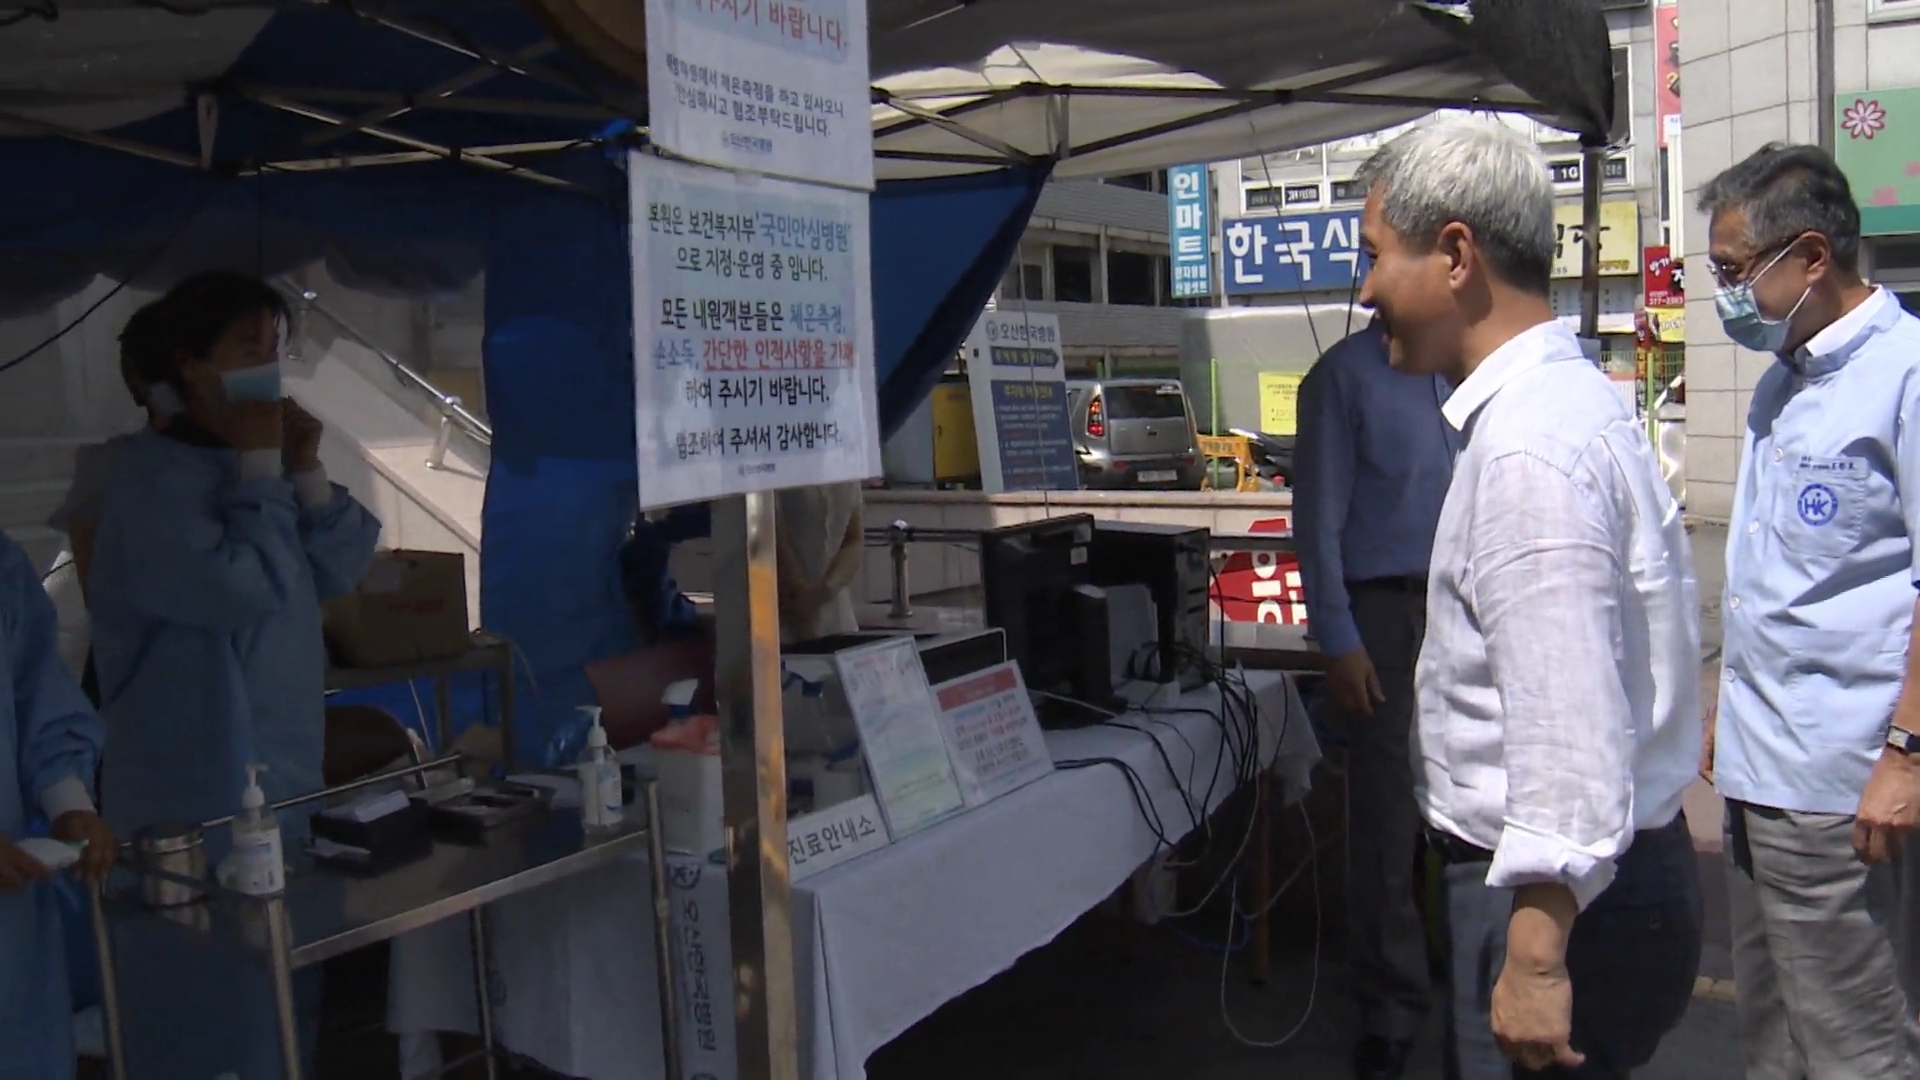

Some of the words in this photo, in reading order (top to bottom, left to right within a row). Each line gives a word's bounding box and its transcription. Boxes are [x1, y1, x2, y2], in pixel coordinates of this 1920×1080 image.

[769, 0, 848, 51] 바랍니다.
[779, 87, 804, 109] 하고
[803, 92, 845, 118] 있사오니
[732, 103, 831, 138] 협조부탁드립니다.
[648, 203, 684, 235] 본원은
[1173, 171, 1203, 261] 인마트
[676, 247, 702, 272] 으로
[770, 253, 783, 280] 중
[788, 256, 828, 282] 입니다.
[1226, 217, 1361, 284] 한국식
[661, 298, 688, 330] 모든
[693, 298, 783, 331] 내원객분들은
[789, 303, 846, 334] 체온측정,
[653, 339, 699, 370] 손소독,
[702, 338, 749, 370] 간단한
[755, 338, 826, 369] 인적사항을
[686, 378, 712, 408] 하여
[717, 376, 763, 407] 주시기
[769, 375, 830, 406] 바랍니다.
[677, 428, 725, 460] 협조하여
[730, 425, 771, 453] 주셔서
[776, 420, 843, 451] 감사합니다.
[787, 814, 876, 866] 진료안내소
